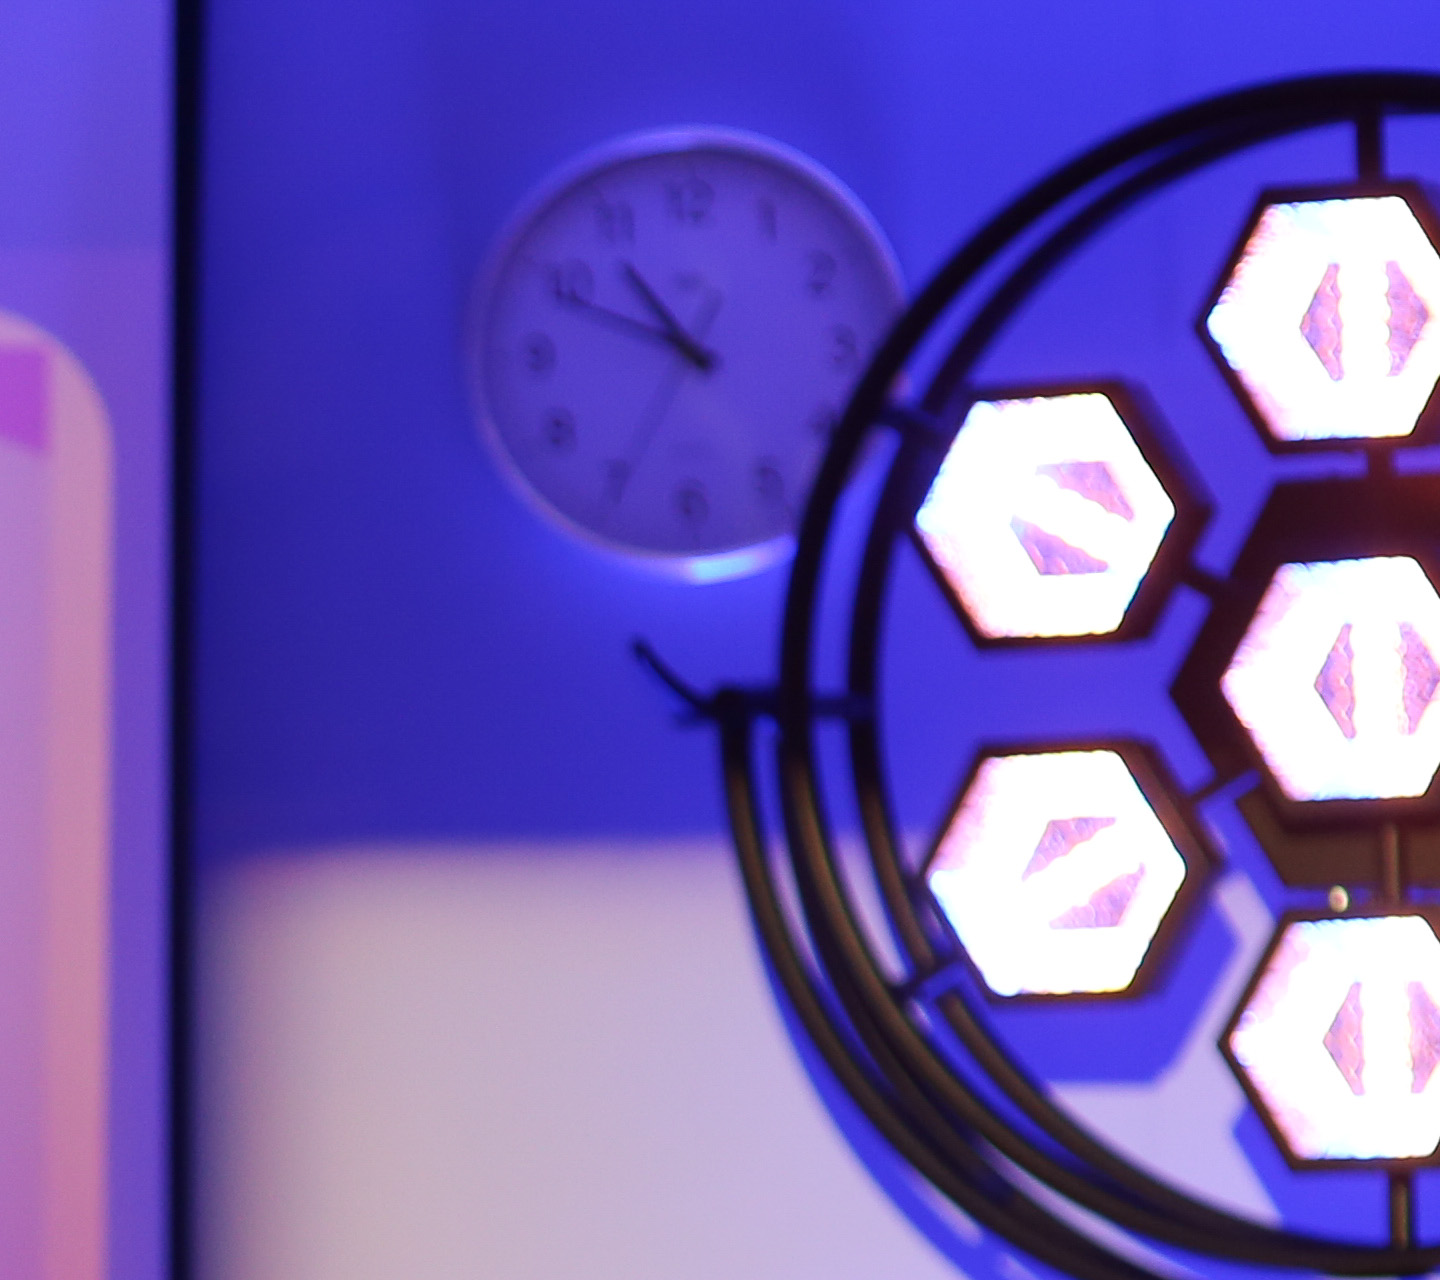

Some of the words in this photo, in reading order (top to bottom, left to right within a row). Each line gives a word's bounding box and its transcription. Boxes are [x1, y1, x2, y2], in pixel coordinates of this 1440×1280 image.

[594, 198, 635, 243] 11
[667, 182, 713, 226] 12
[805, 253, 834, 298] 2
[522, 336, 553, 379] 9
[826, 327, 855, 370] 3
[543, 409, 573, 453] 8
[674, 481, 705, 523] 6
